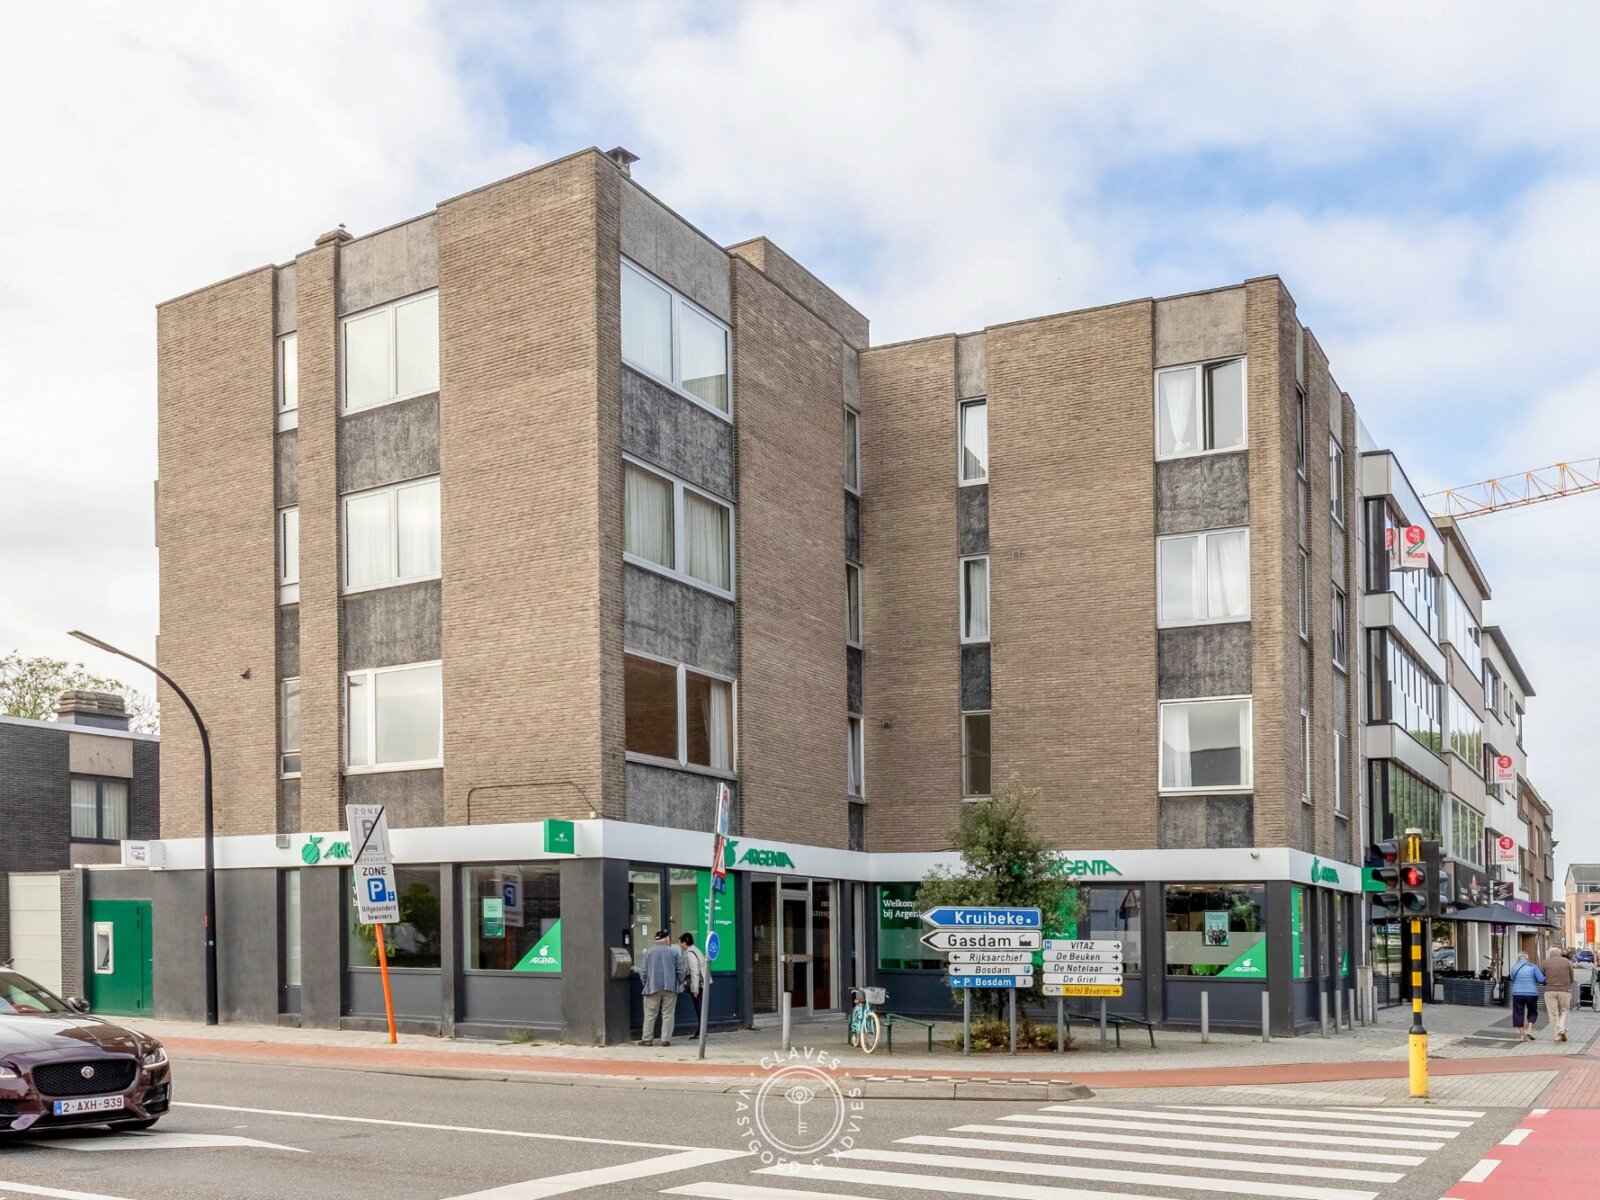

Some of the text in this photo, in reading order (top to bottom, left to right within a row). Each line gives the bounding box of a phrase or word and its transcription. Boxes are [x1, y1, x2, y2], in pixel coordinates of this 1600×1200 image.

[738, 848, 795, 869] ARGENTA
[362, 866, 387, 876] ZONE
[362, 904, 396, 914] Uitgezonderd
[883, 910, 893, 919] bij
[954, 910, 1024, 924] Kruibeke
[947, 934, 1012, 947] Gasdam
[1071, 941, 1095, 950] VITAZ
[969, 953, 1023, 963] Rijksarchief
[1056, 952, 1101, 961] De Beuken
[975, 966, 1011, 974] Bosdam
[1053, 964, 1104, 972] De Notelaar
[964, 977, 1012, 986] P Bosdam
[1063, 975, 1097, 983] De Griel
[1084, 987, 1111, 995] Beveren
